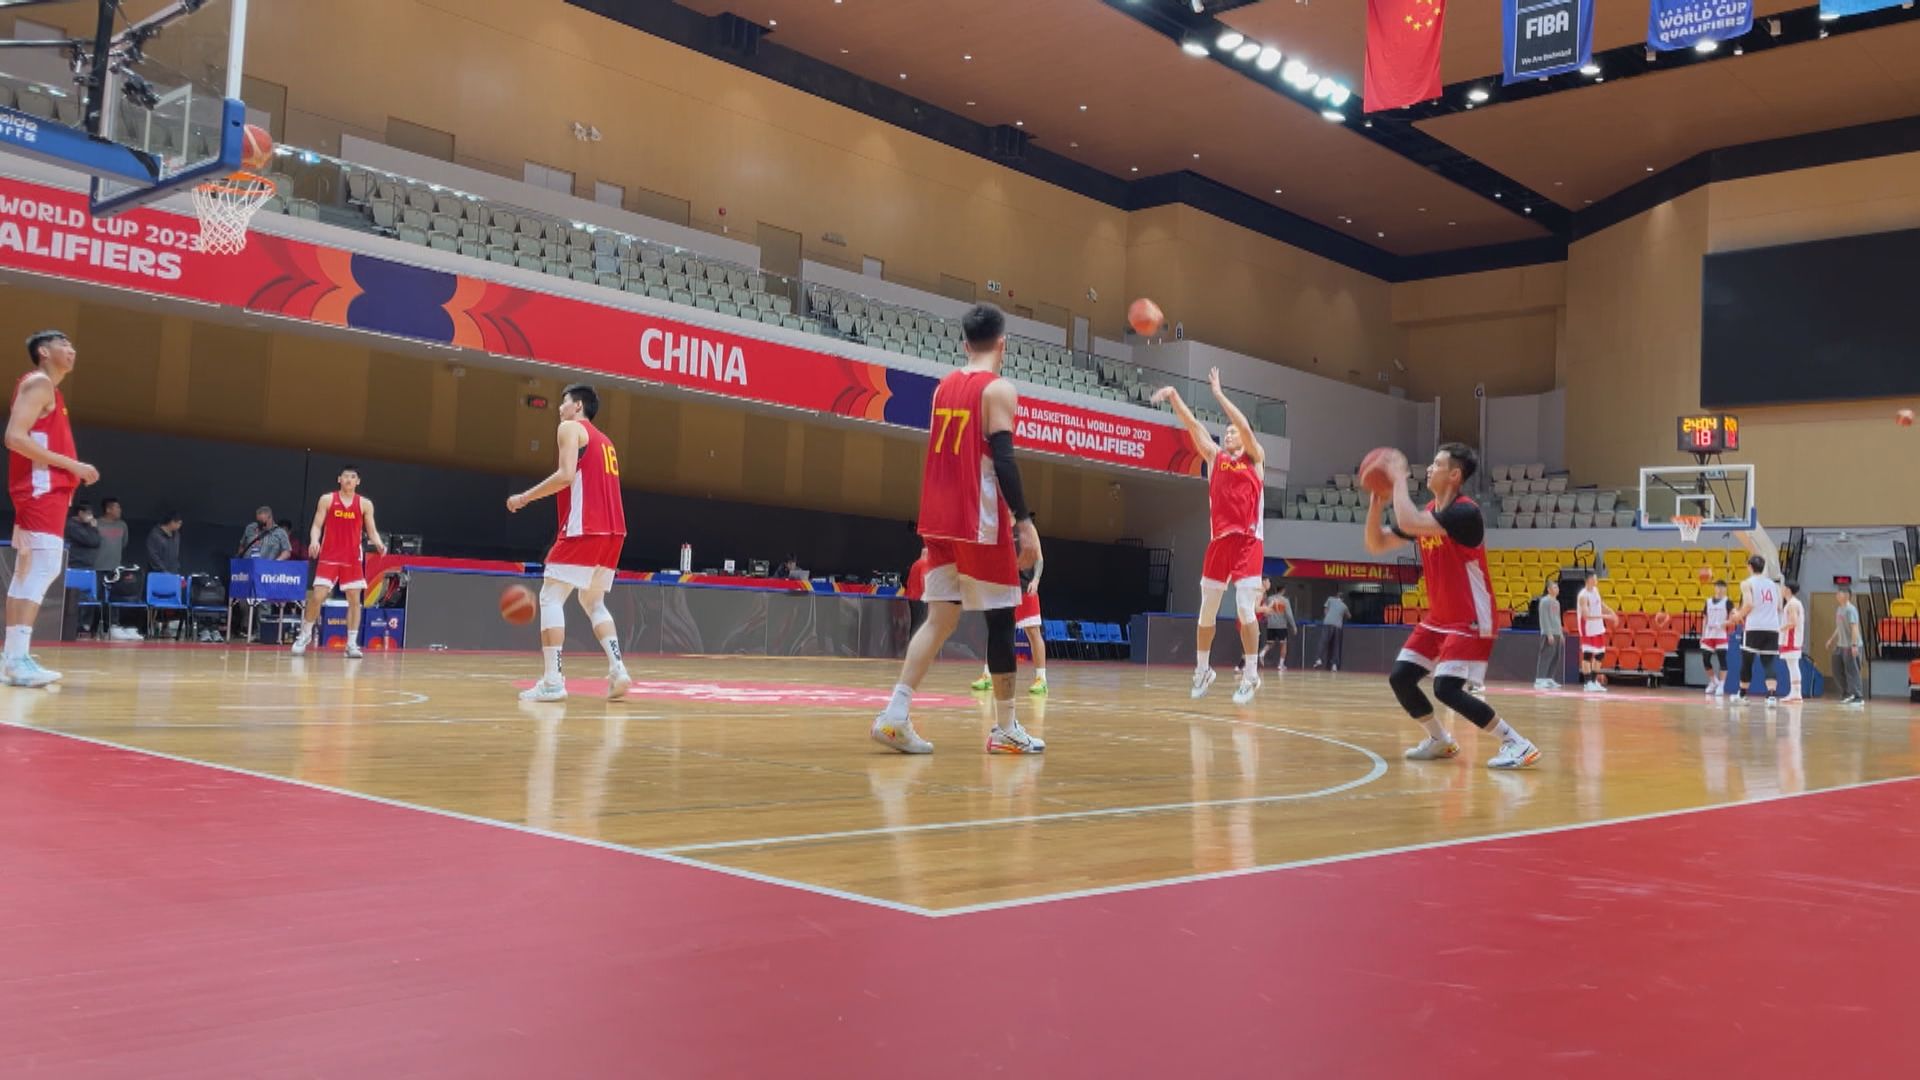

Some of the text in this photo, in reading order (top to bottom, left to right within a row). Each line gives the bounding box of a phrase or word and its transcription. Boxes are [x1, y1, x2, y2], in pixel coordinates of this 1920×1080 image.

[1526, 10, 1569, 39] FIBA
[1660, 2, 1747, 29] WORLD CUP
[1660, 16, 1746, 43] QUALIFIERS
[0, 195, 201, 252] WORLD CUP 2023
[640, 327, 748, 386] CHINA
[934, 407, 971, 456] 77
[1015, 419, 1146, 459] ASIAN QUALIFIERS
[1031, 407, 1086, 429] BASKETBALL
[1087, 418, 1115, 435] WORLD
[1116, 423, 1131, 437] CUP
[1133, 427, 1152, 442] 2023
[1696, 429, 1712, 446] 18
[601, 443, 619, 476] 16
[260, 573, 301, 586] molten
[1324, 562, 1349, 577] WIN
[1761, 589, 1773, 604] 14
